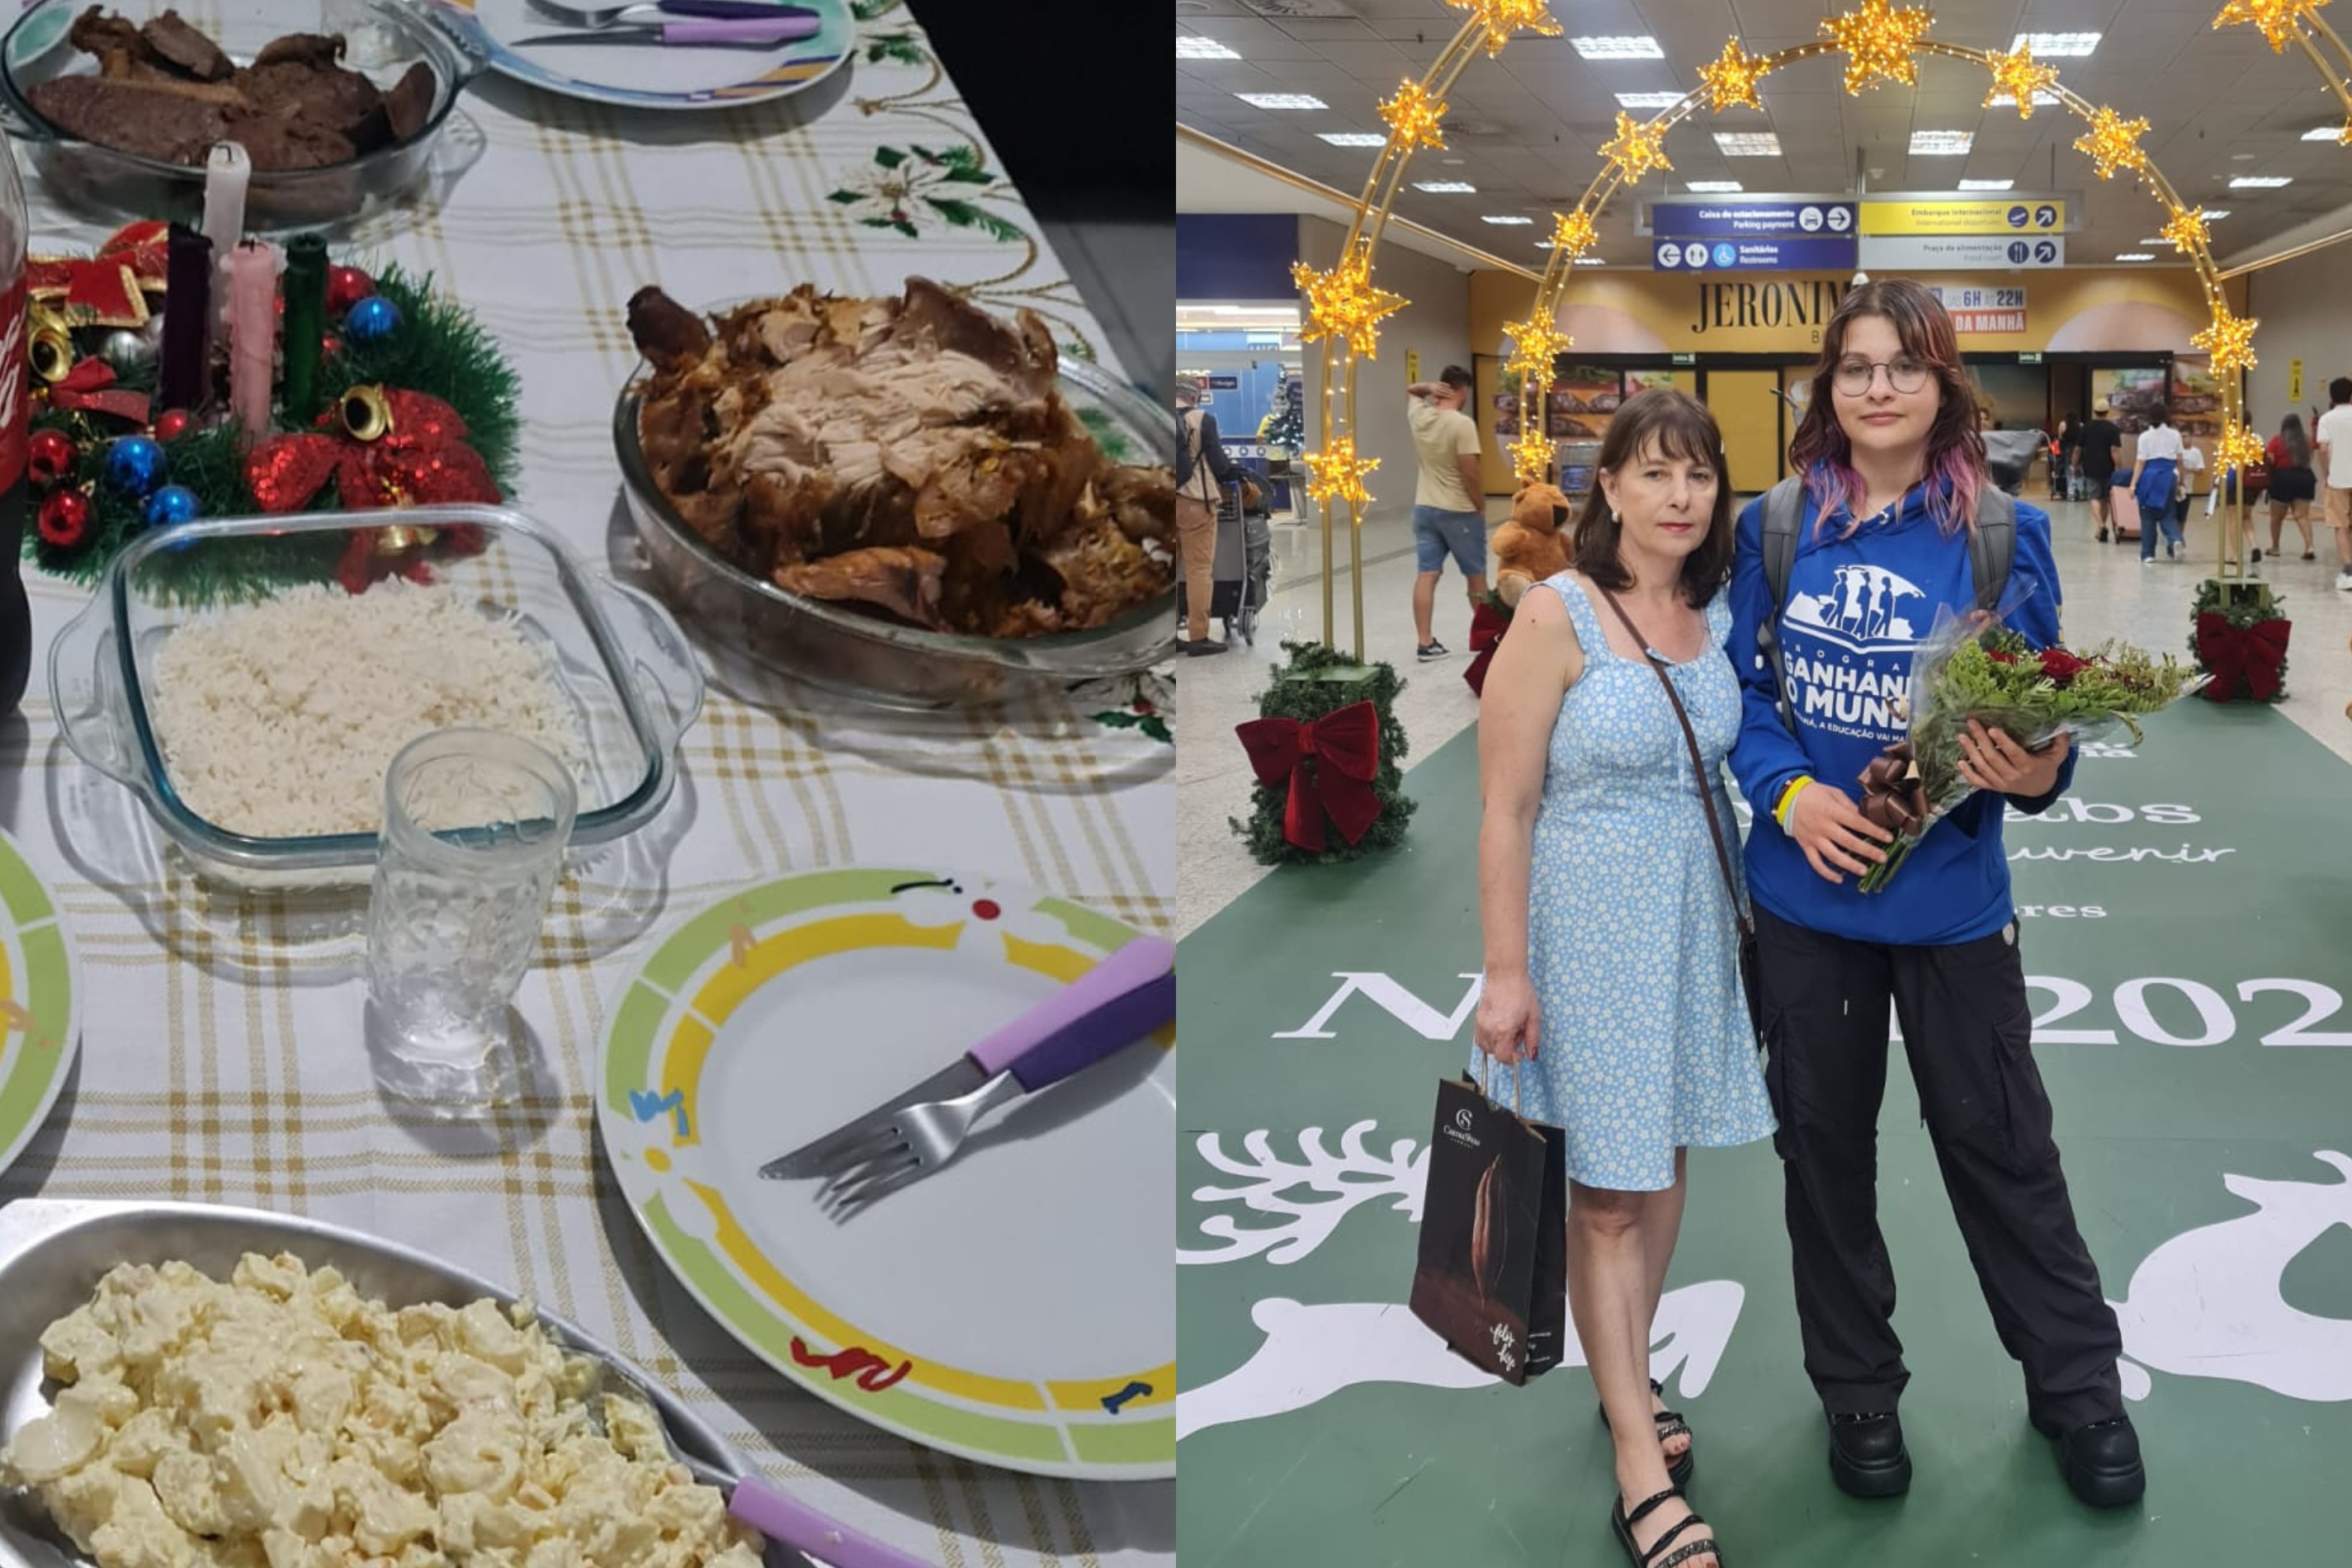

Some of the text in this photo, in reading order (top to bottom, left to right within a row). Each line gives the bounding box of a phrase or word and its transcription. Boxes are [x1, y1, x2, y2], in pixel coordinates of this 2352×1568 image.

[1699, 210, 1795, 219] Caixa de estacionamento
[1911, 208, 2002, 217] Embarque internacional
[1733, 220, 1795, 230] Parking payment
[1740, 244, 1778, 253] Sanitários
[1957, 243, 2002, 253] alimentação
[1740, 256, 1778, 264] Restrooms
[1963, 290, 1981, 307] 6H
[1996, 289, 2024, 306] 22H
[1691, 281, 1852, 333] JERONIM
[1955, 311, 2024, 332] DA MANHÃ
[1784, 651, 1911, 699] GANHAN
[1827, 723, 1874, 739] EDUCAÇÃO
[1876, 733, 1890, 742] VAI
[2014, 904, 2108, 918] res
